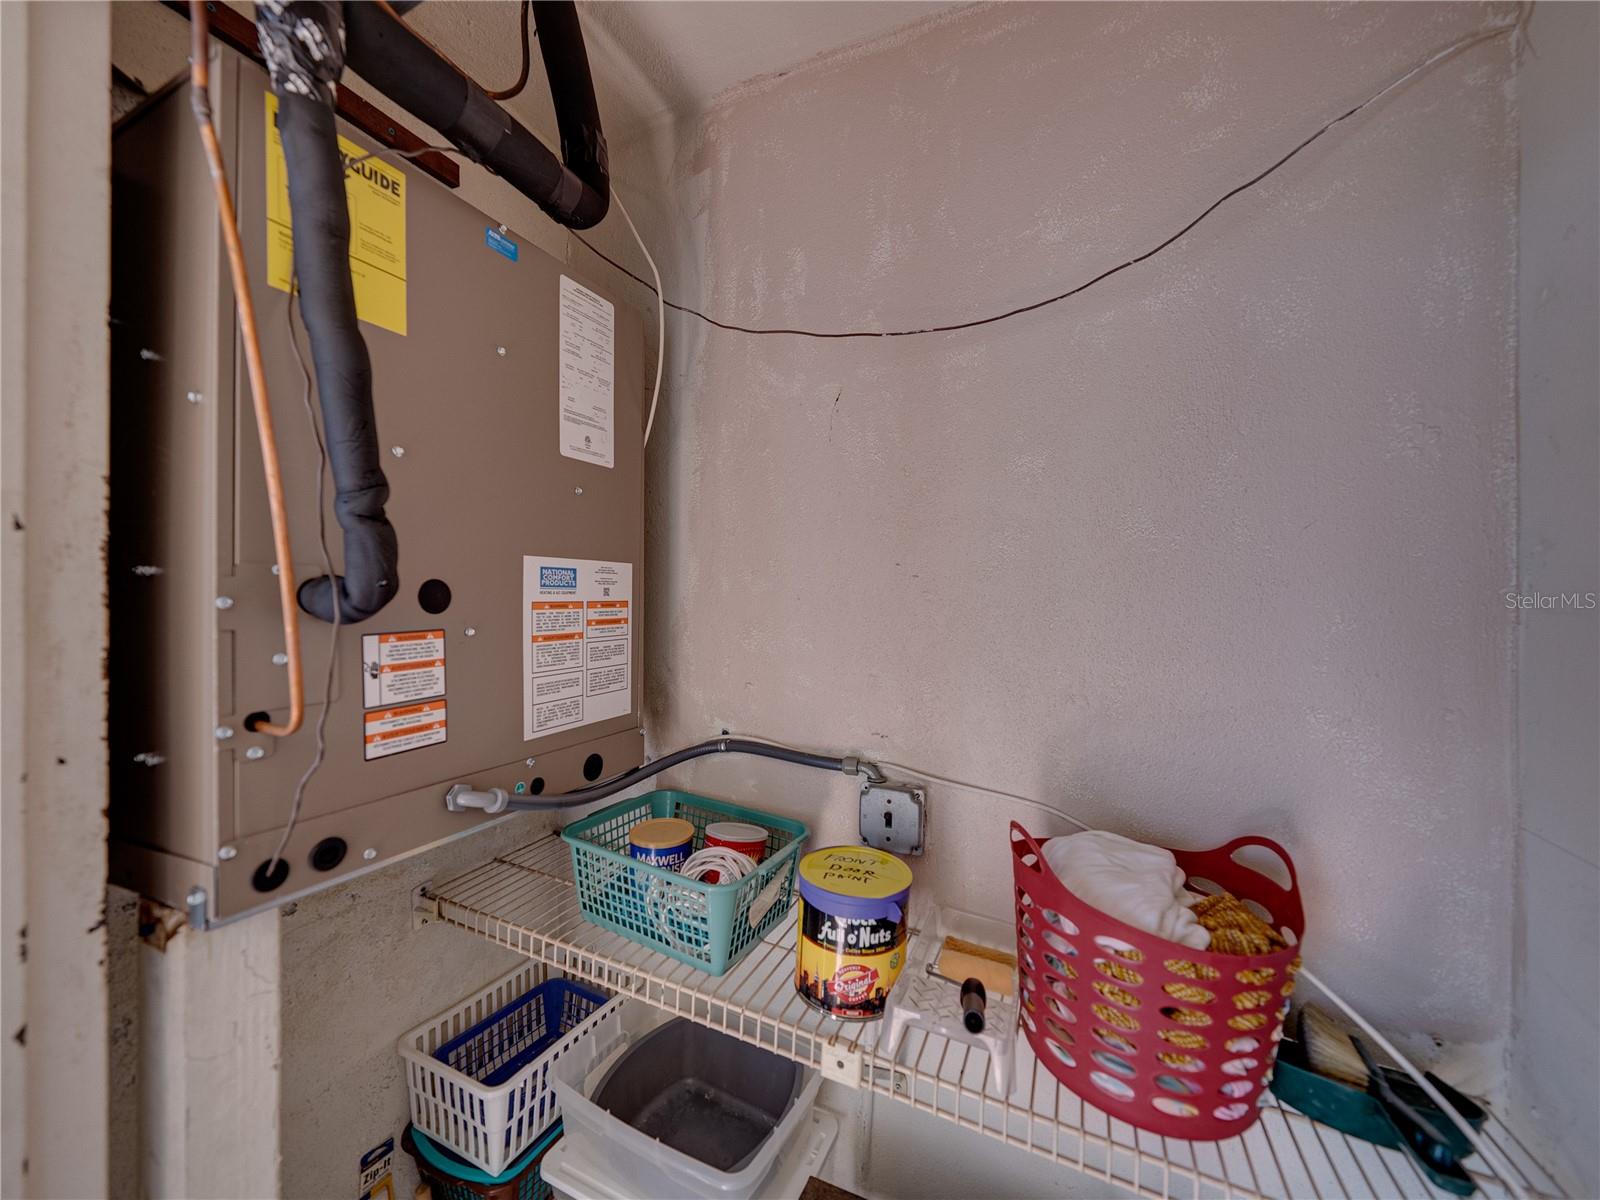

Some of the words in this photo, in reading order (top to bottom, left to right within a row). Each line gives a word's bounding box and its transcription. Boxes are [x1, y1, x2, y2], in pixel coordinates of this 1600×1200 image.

[636, 851, 685, 867] MAXWELL
[817, 921, 845, 942] full
[834, 970, 873, 997] Original
